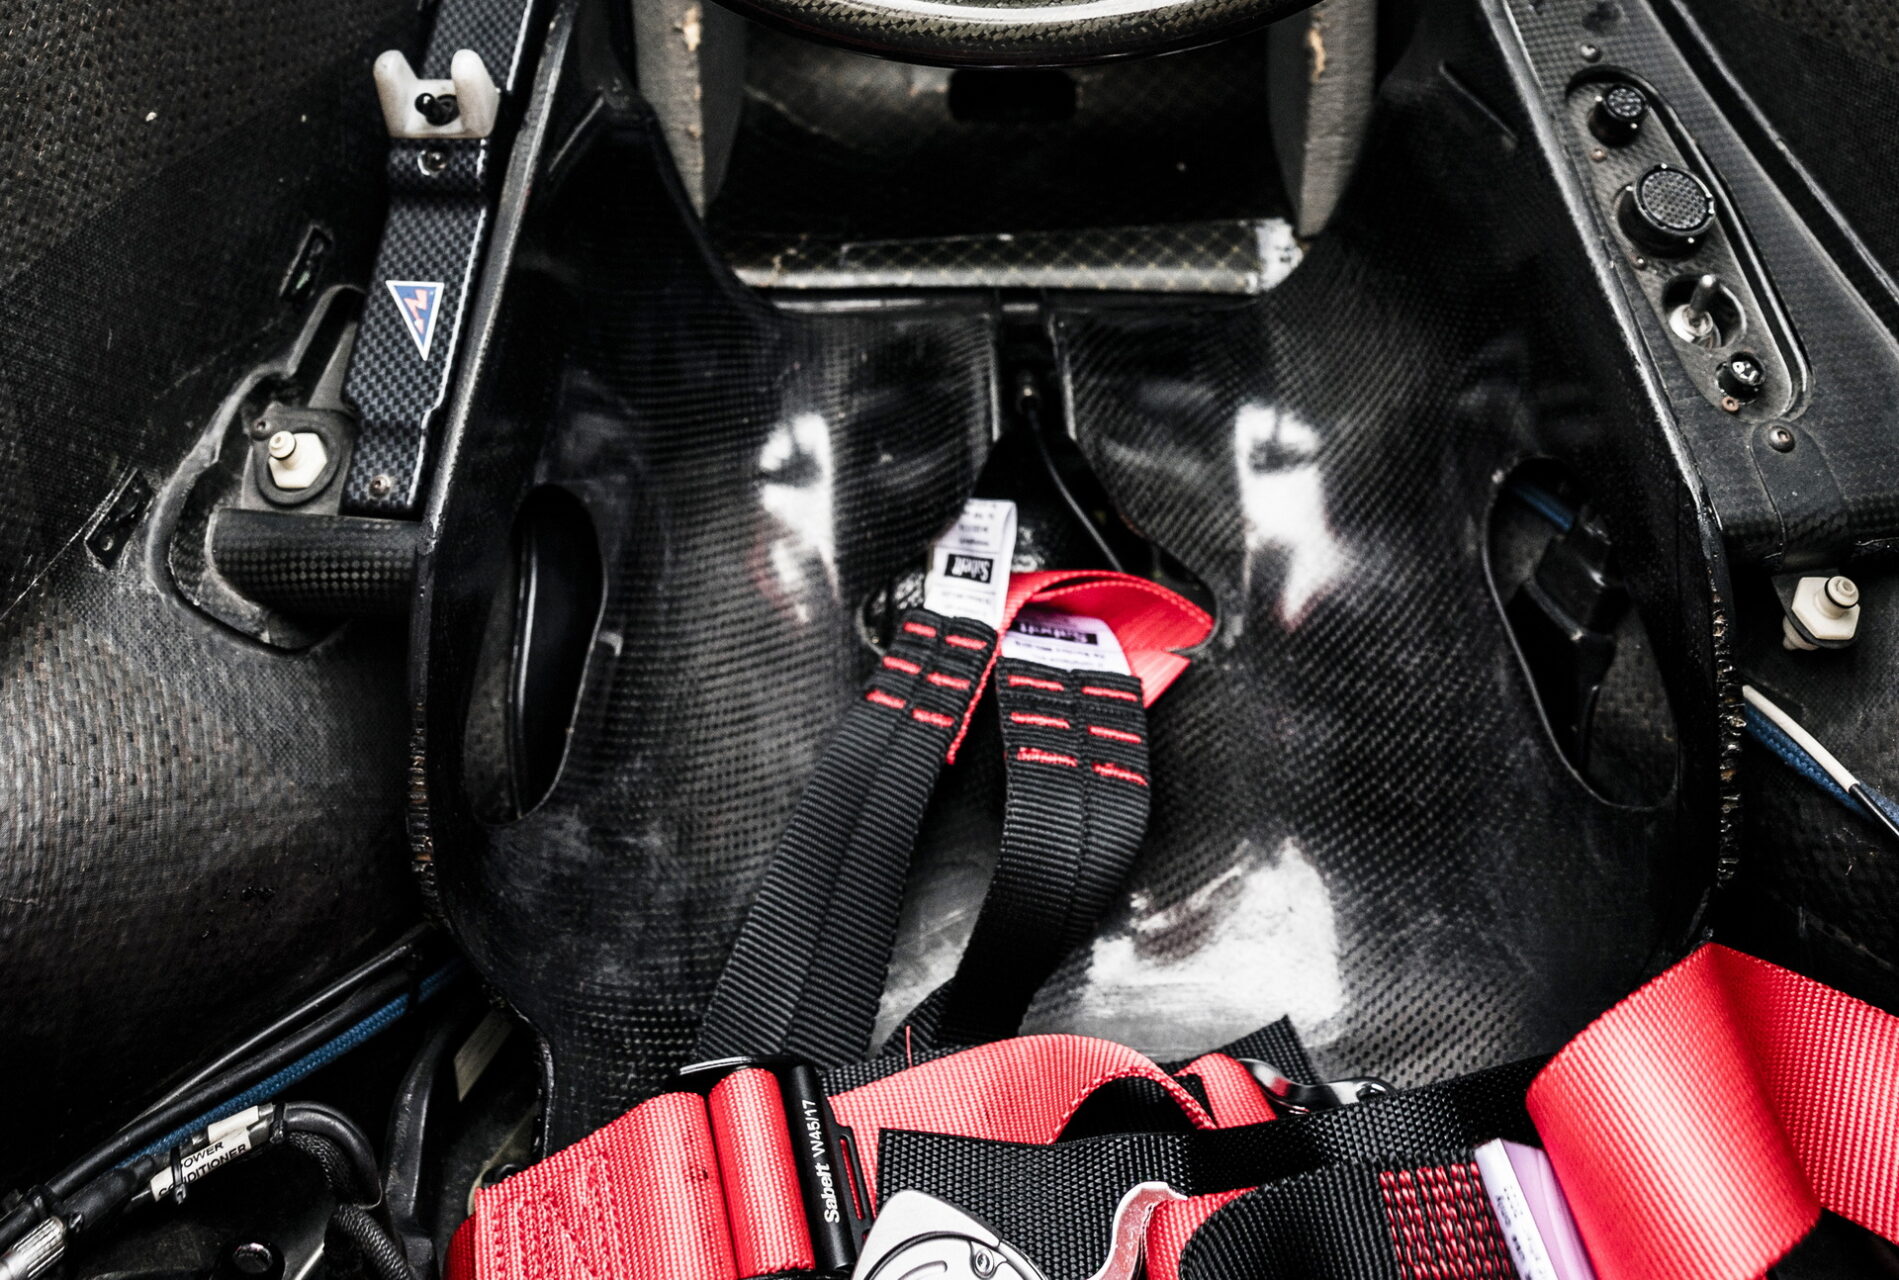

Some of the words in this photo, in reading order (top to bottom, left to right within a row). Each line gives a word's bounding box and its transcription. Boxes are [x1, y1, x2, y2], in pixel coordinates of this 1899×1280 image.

[181, 1141, 224, 1168] OWER
[802, 1099, 826, 1158] W45/17
[159, 1143, 247, 1196] CODITIONER
[815, 1162, 840, 1223] Sabelt
